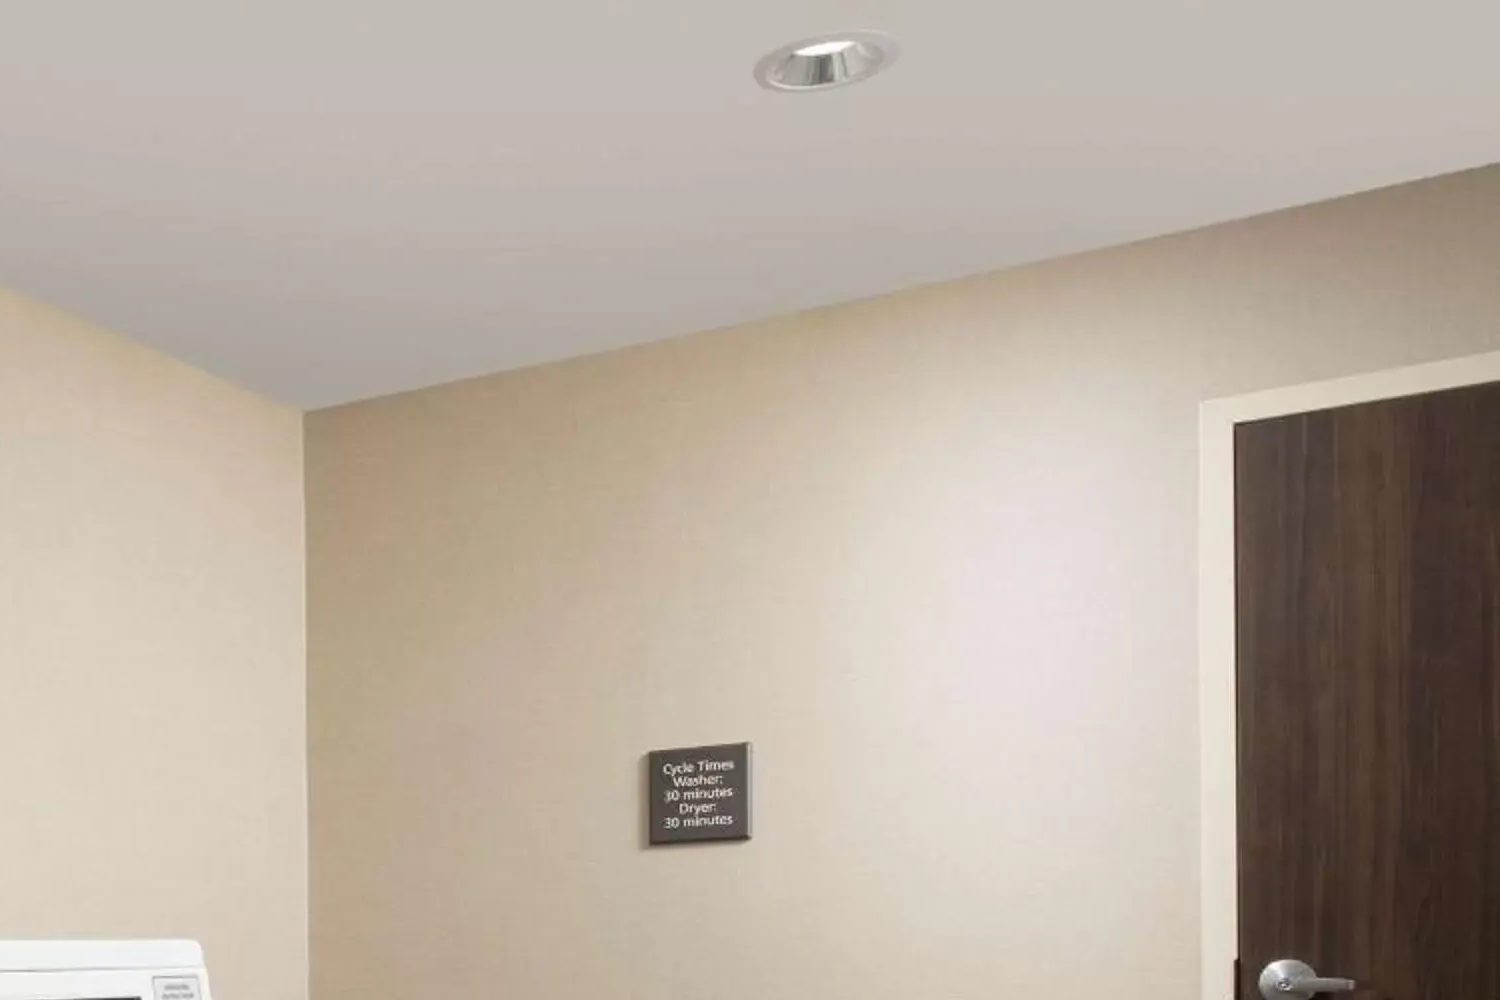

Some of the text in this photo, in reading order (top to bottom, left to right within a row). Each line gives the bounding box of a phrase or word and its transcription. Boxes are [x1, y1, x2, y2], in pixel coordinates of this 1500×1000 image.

[662, 760, 735, 776] Cycle Times
[673, 775, 723, 788] Washer:
[664, 788, 733, 803] 30 minutes
[679, 803, 717, 816] Dryer:
[663, 815, 733, 829] 30 minutes
